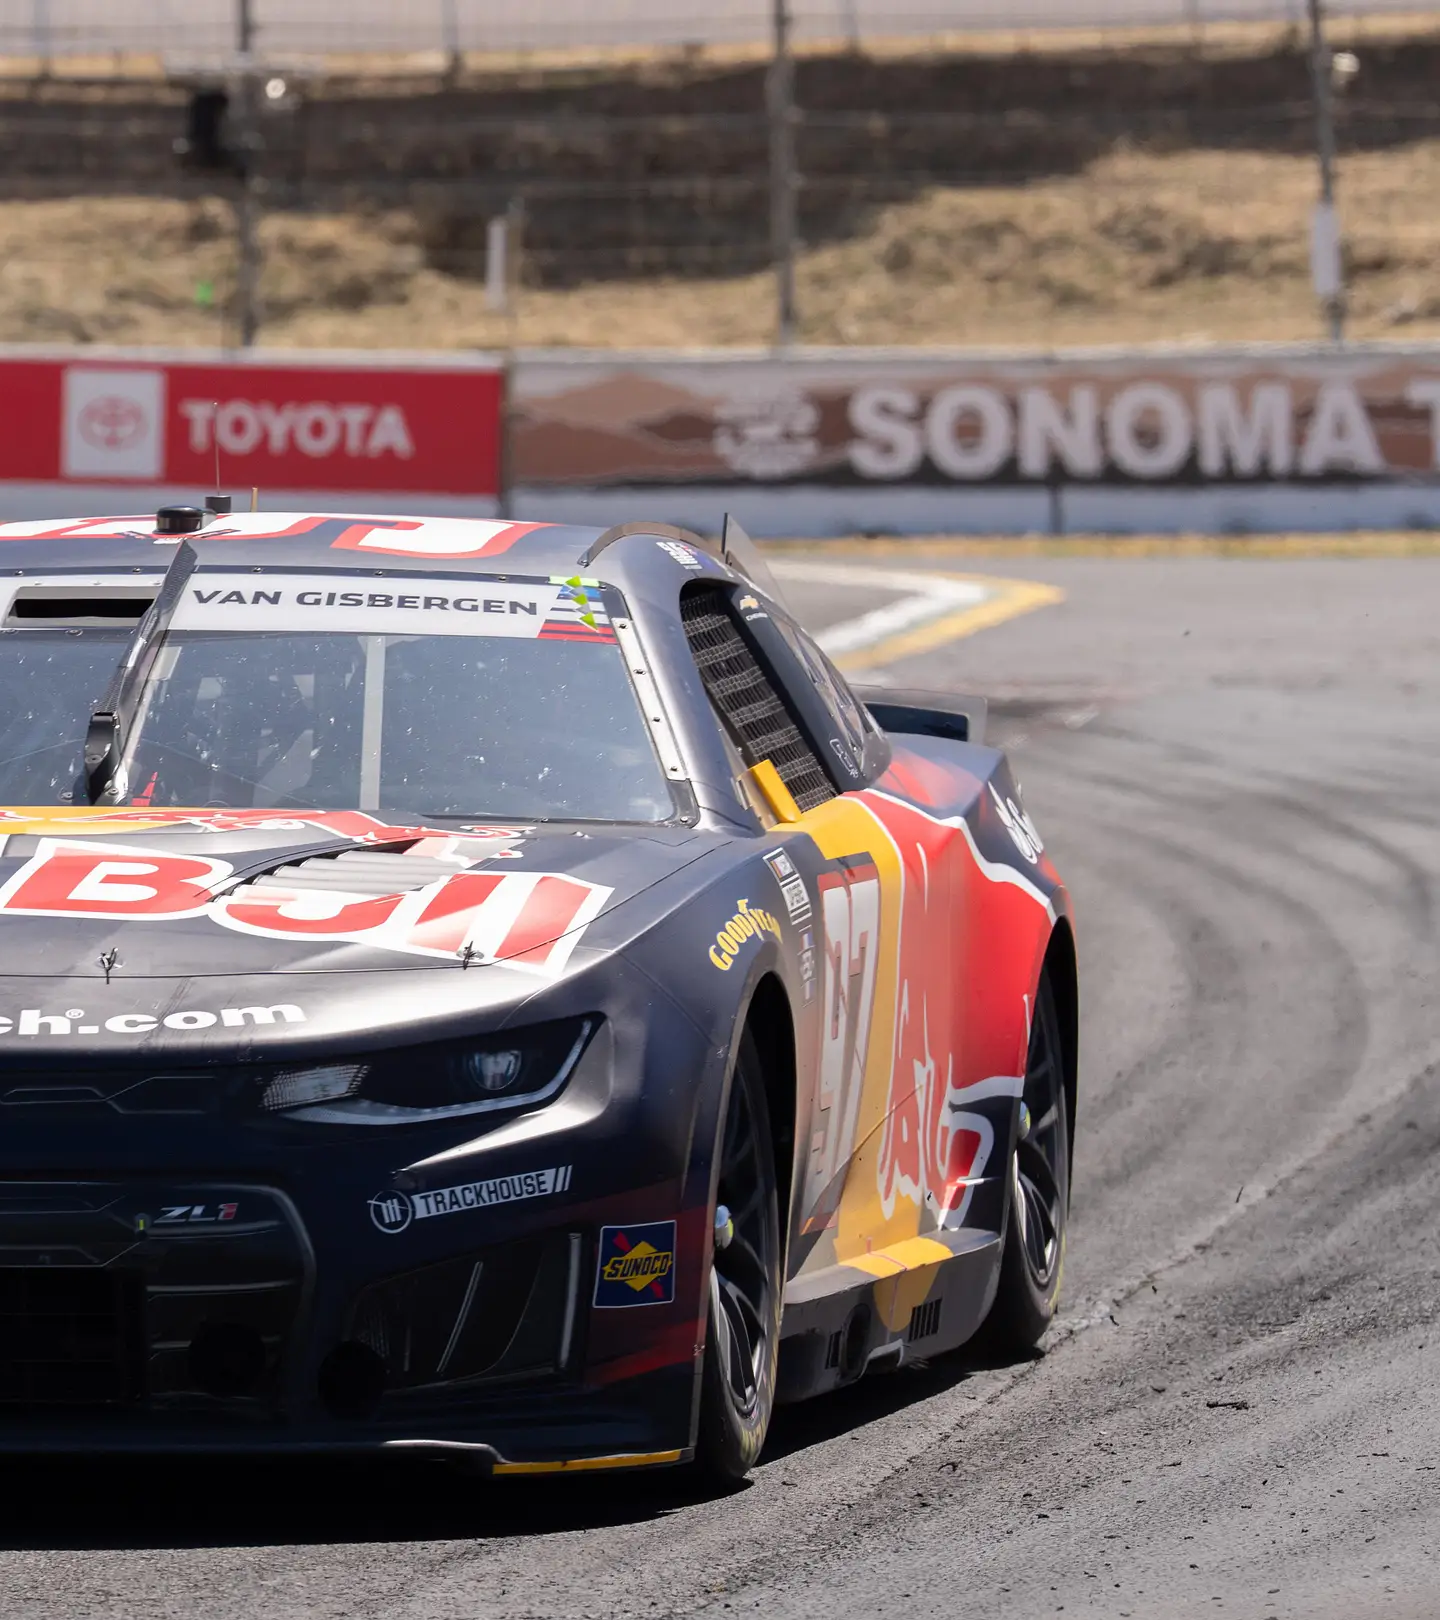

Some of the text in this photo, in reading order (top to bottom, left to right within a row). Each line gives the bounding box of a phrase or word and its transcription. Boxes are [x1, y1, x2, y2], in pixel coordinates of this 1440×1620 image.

[178, 398, 415, 459] TOYOTA
[848, 380, 1386, 480] SONOMA
[192, 589, 539, 616] VAN GISBERGEN
[418, 1171, 550, 1213] TRACKHOUSE
[153, 1202, 240, 1224] ZL1
[606, 1255, 671, 1280] SUNOCO
